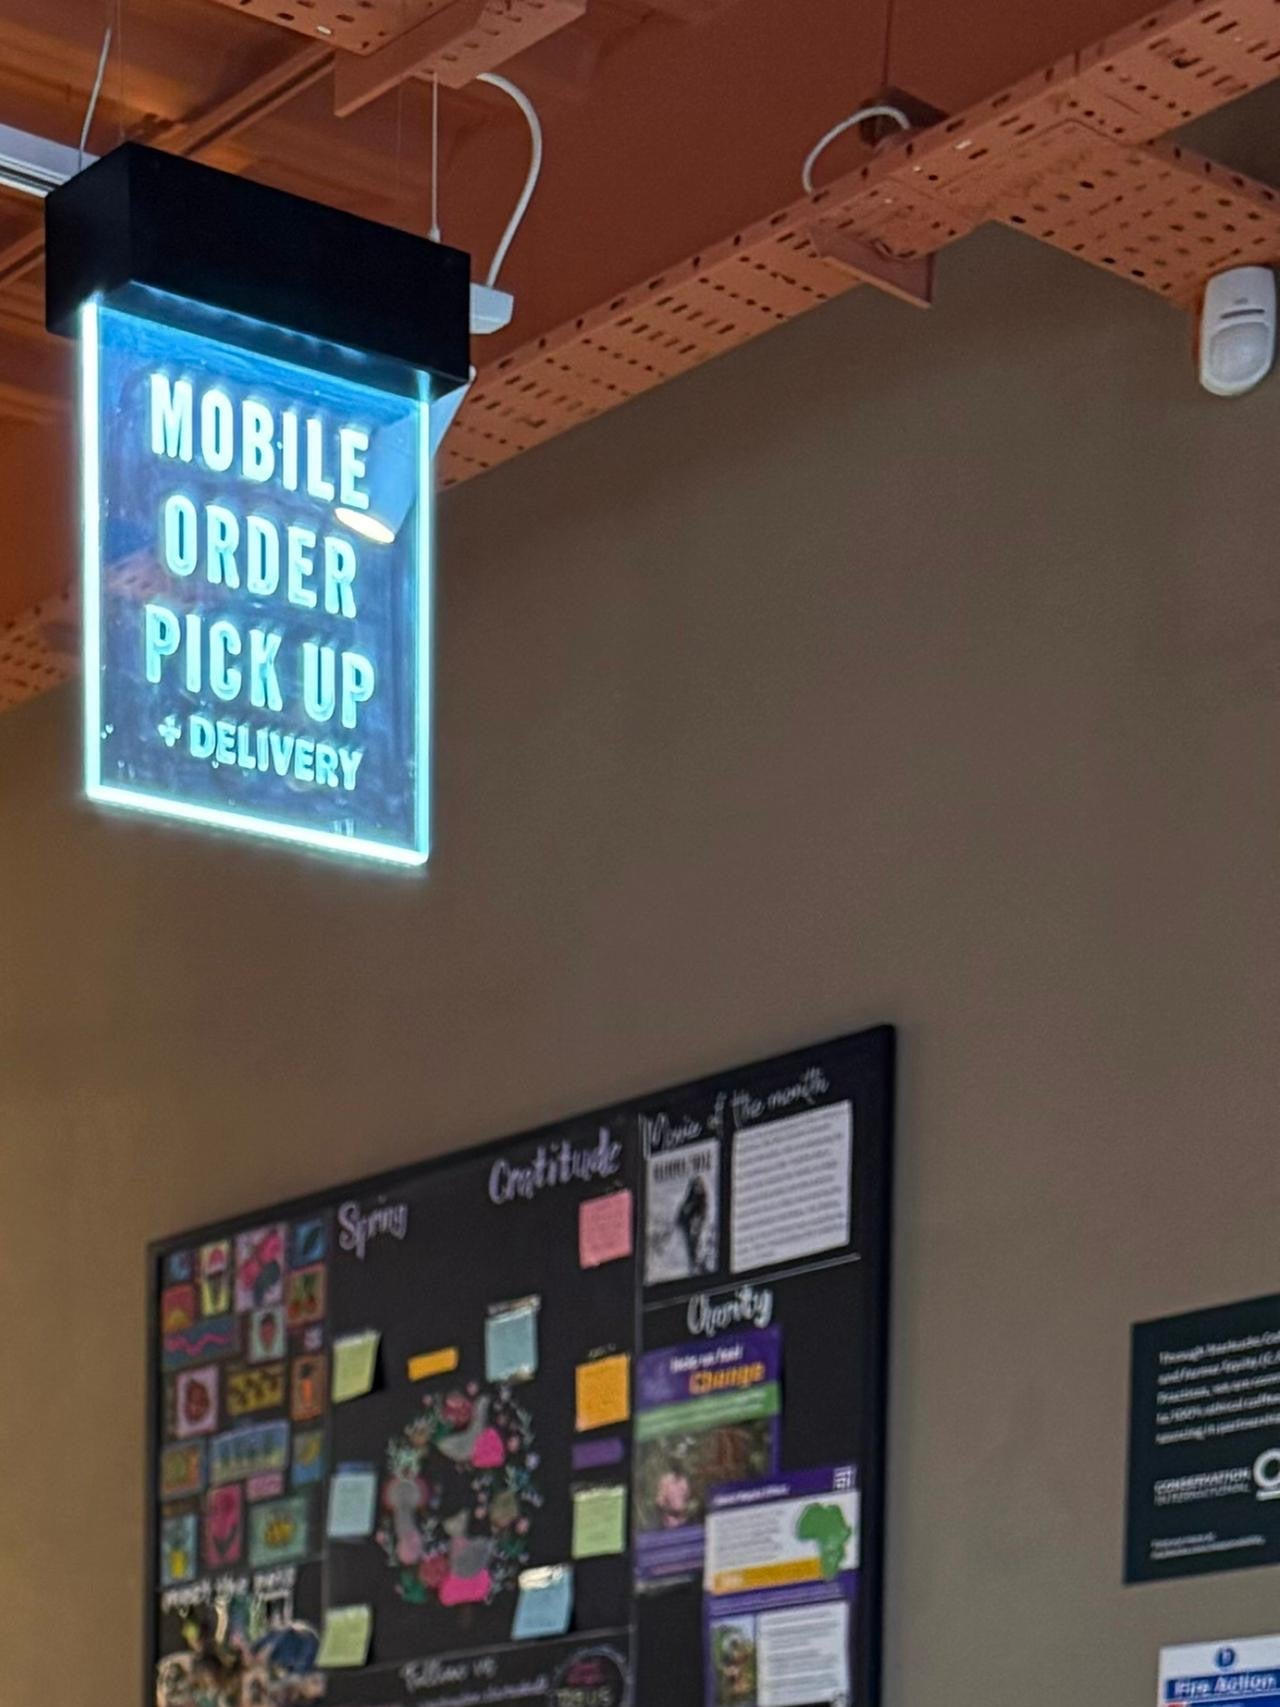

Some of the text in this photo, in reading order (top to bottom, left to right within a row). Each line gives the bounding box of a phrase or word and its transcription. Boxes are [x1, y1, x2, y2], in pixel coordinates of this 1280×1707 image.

[149, 372, 370, 511] MOBILE
[164, 494, 358, 619] ORDER
[144, 603, 376, 730] PICK UP
[189, 713, 365, 792] DELIVERY
[337, 1195, 409, 1261] Spring
[686, 1284, 774, 1338] Charity
